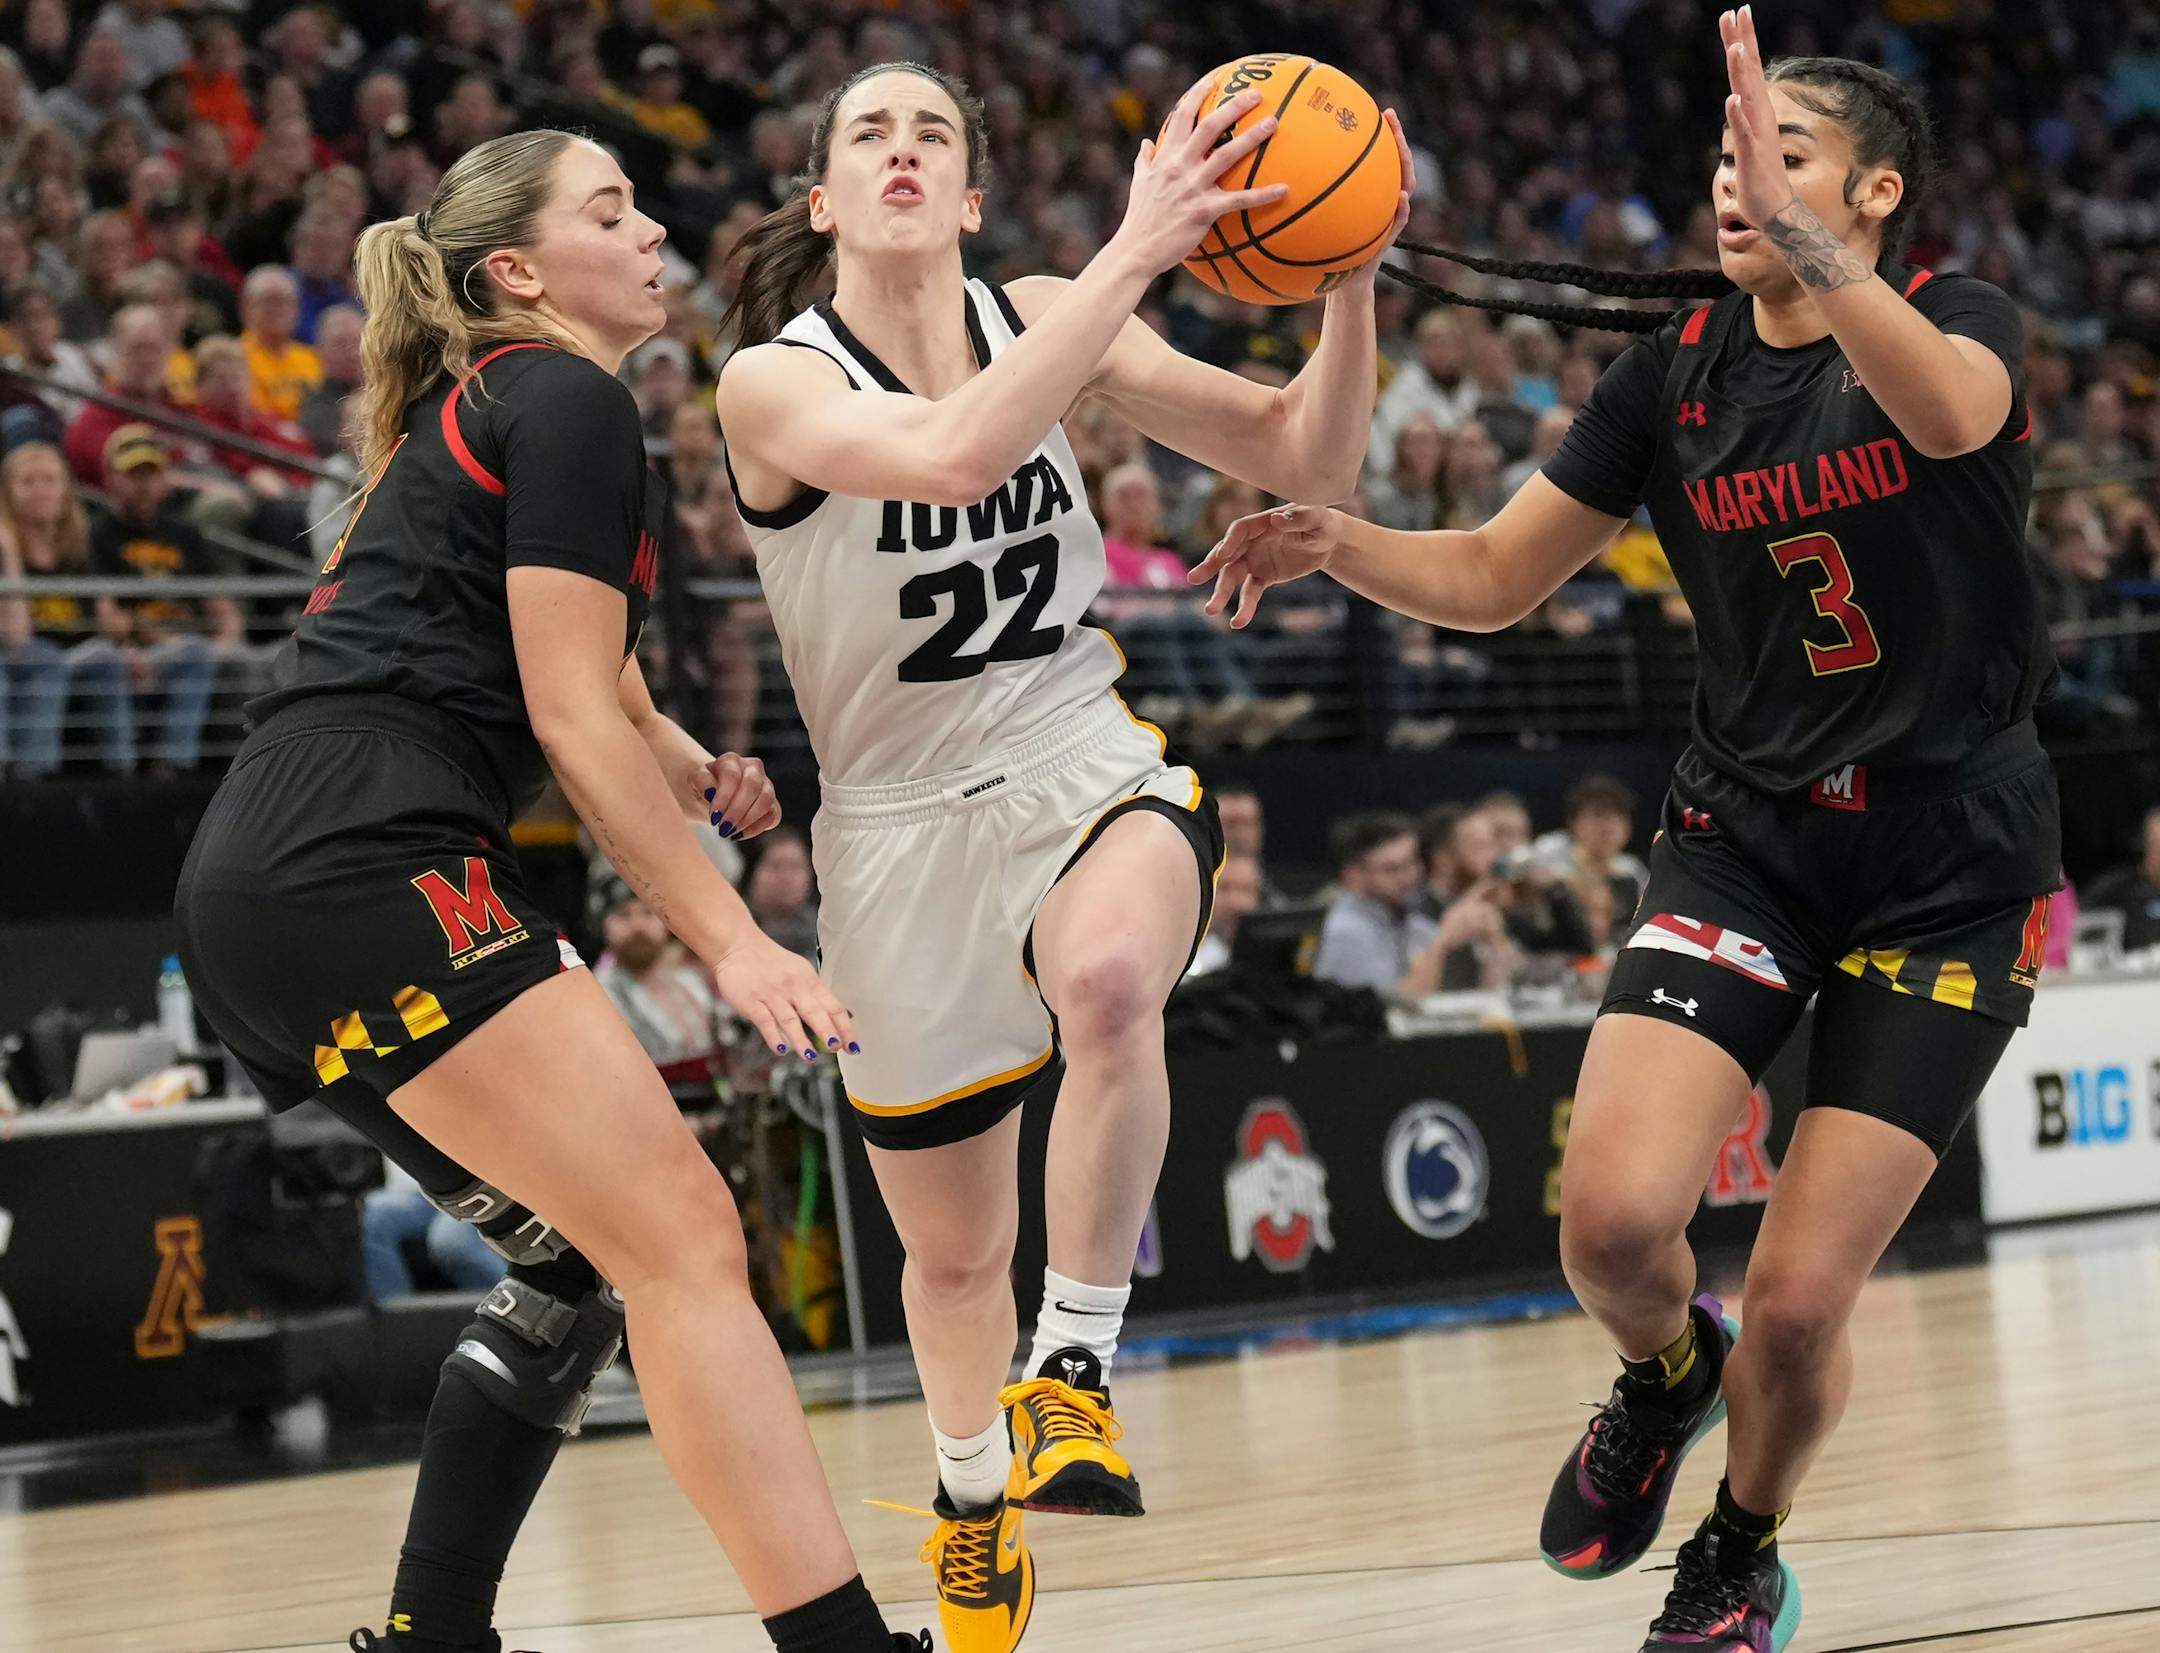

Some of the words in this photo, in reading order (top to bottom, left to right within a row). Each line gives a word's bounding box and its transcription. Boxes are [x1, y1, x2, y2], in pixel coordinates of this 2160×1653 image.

[876, 453, 1073, 553] IOWA
[1682, 438, 1910, 532] MARYLAND
[898, 532, 1064, 683] 22
[1766, 531, 1881, 677] 3
[962, 775, 1006, 799] HAWKEYES
[1822, 764, 1856, 799] M
[410, 856, 522, 958] M
